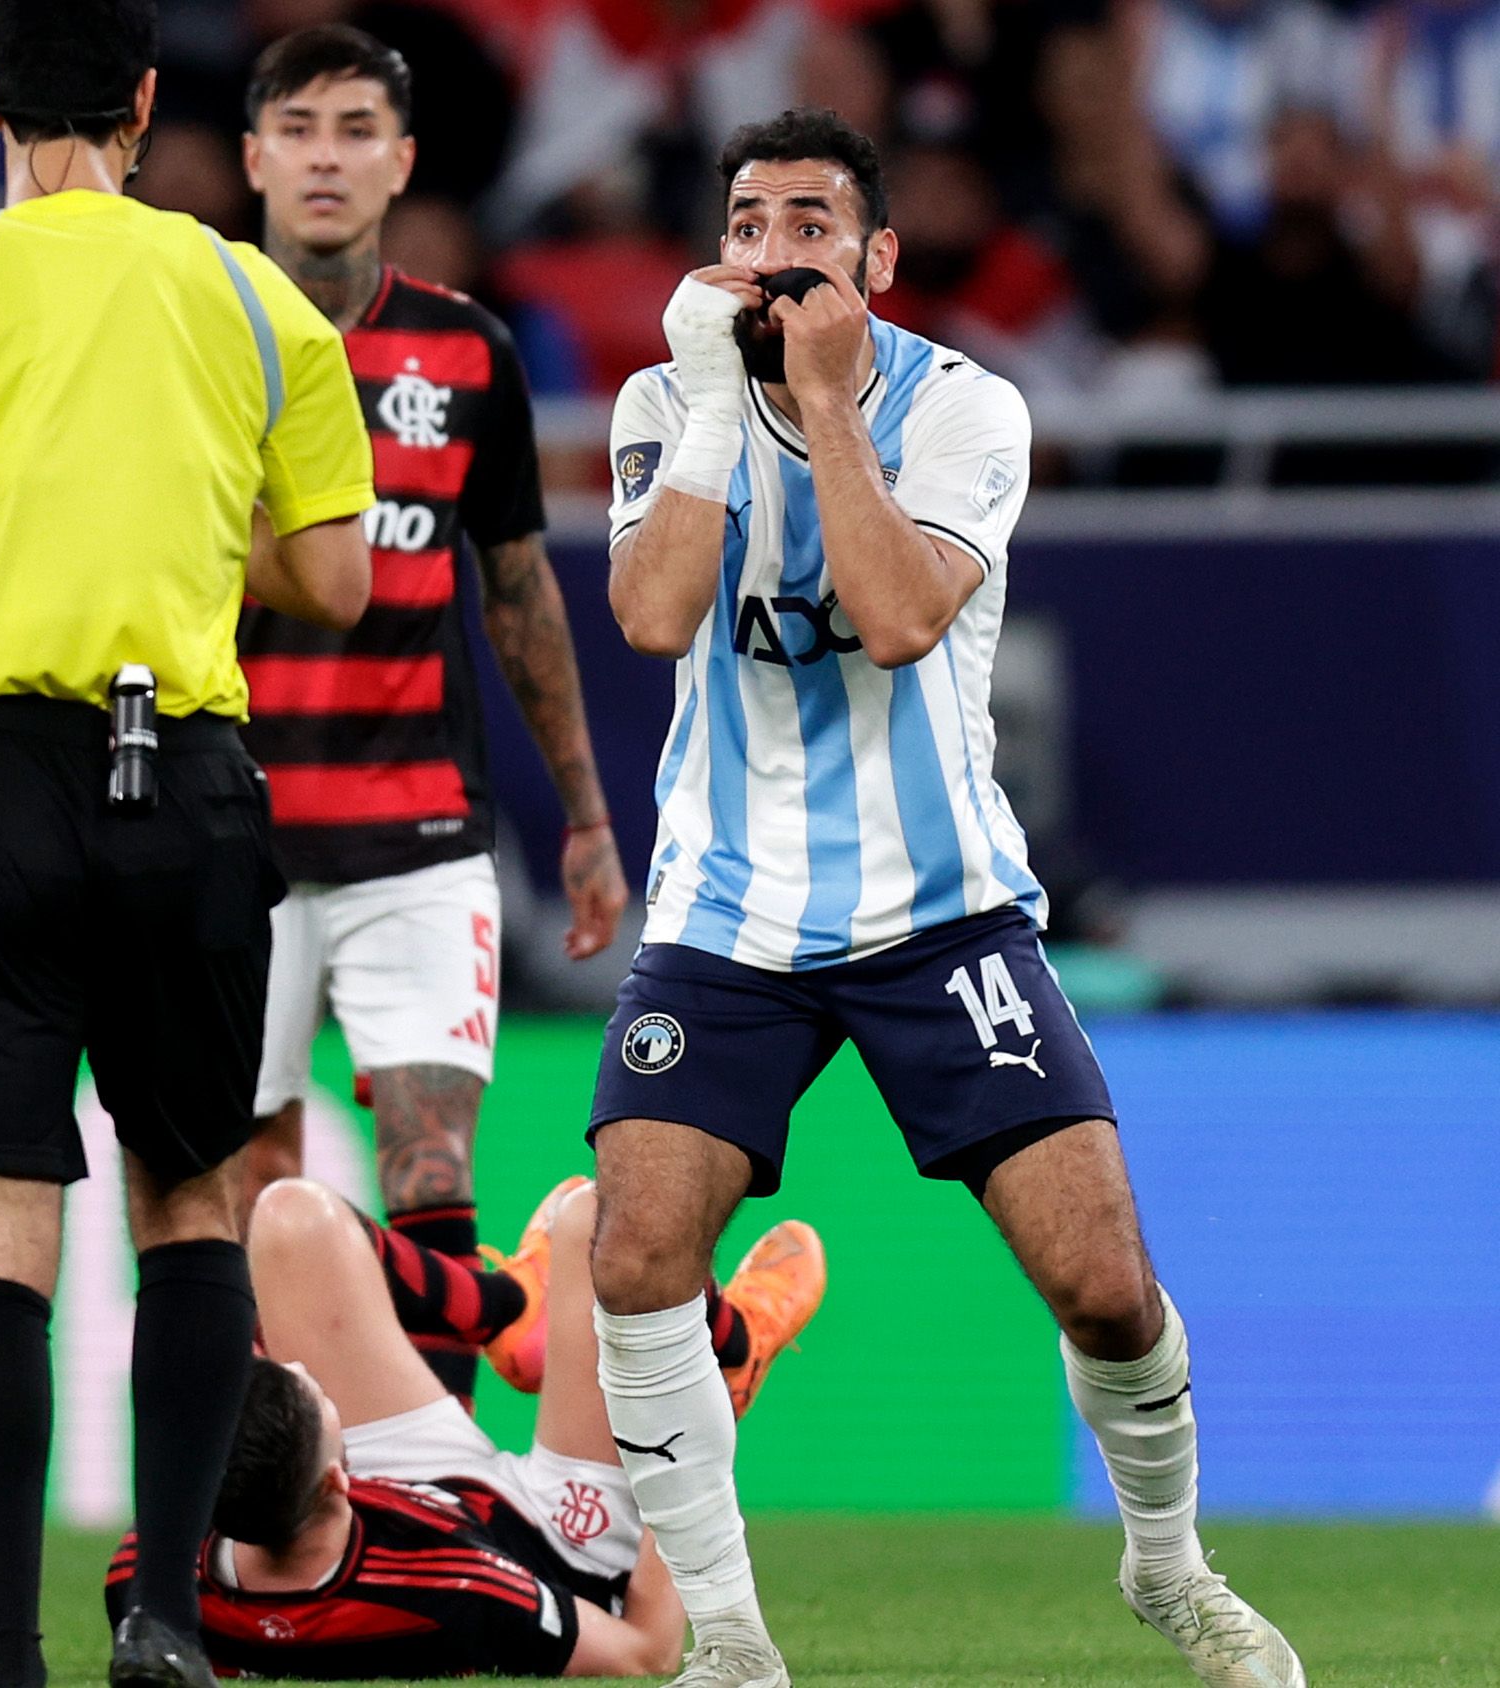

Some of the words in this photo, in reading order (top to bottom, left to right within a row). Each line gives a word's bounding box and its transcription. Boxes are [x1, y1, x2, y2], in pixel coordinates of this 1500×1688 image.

[471, 910, 496, 999] 5
[631, 1018, 678, 1038] PYRAMIDS
[944, 952, 1035, 1050] 14
